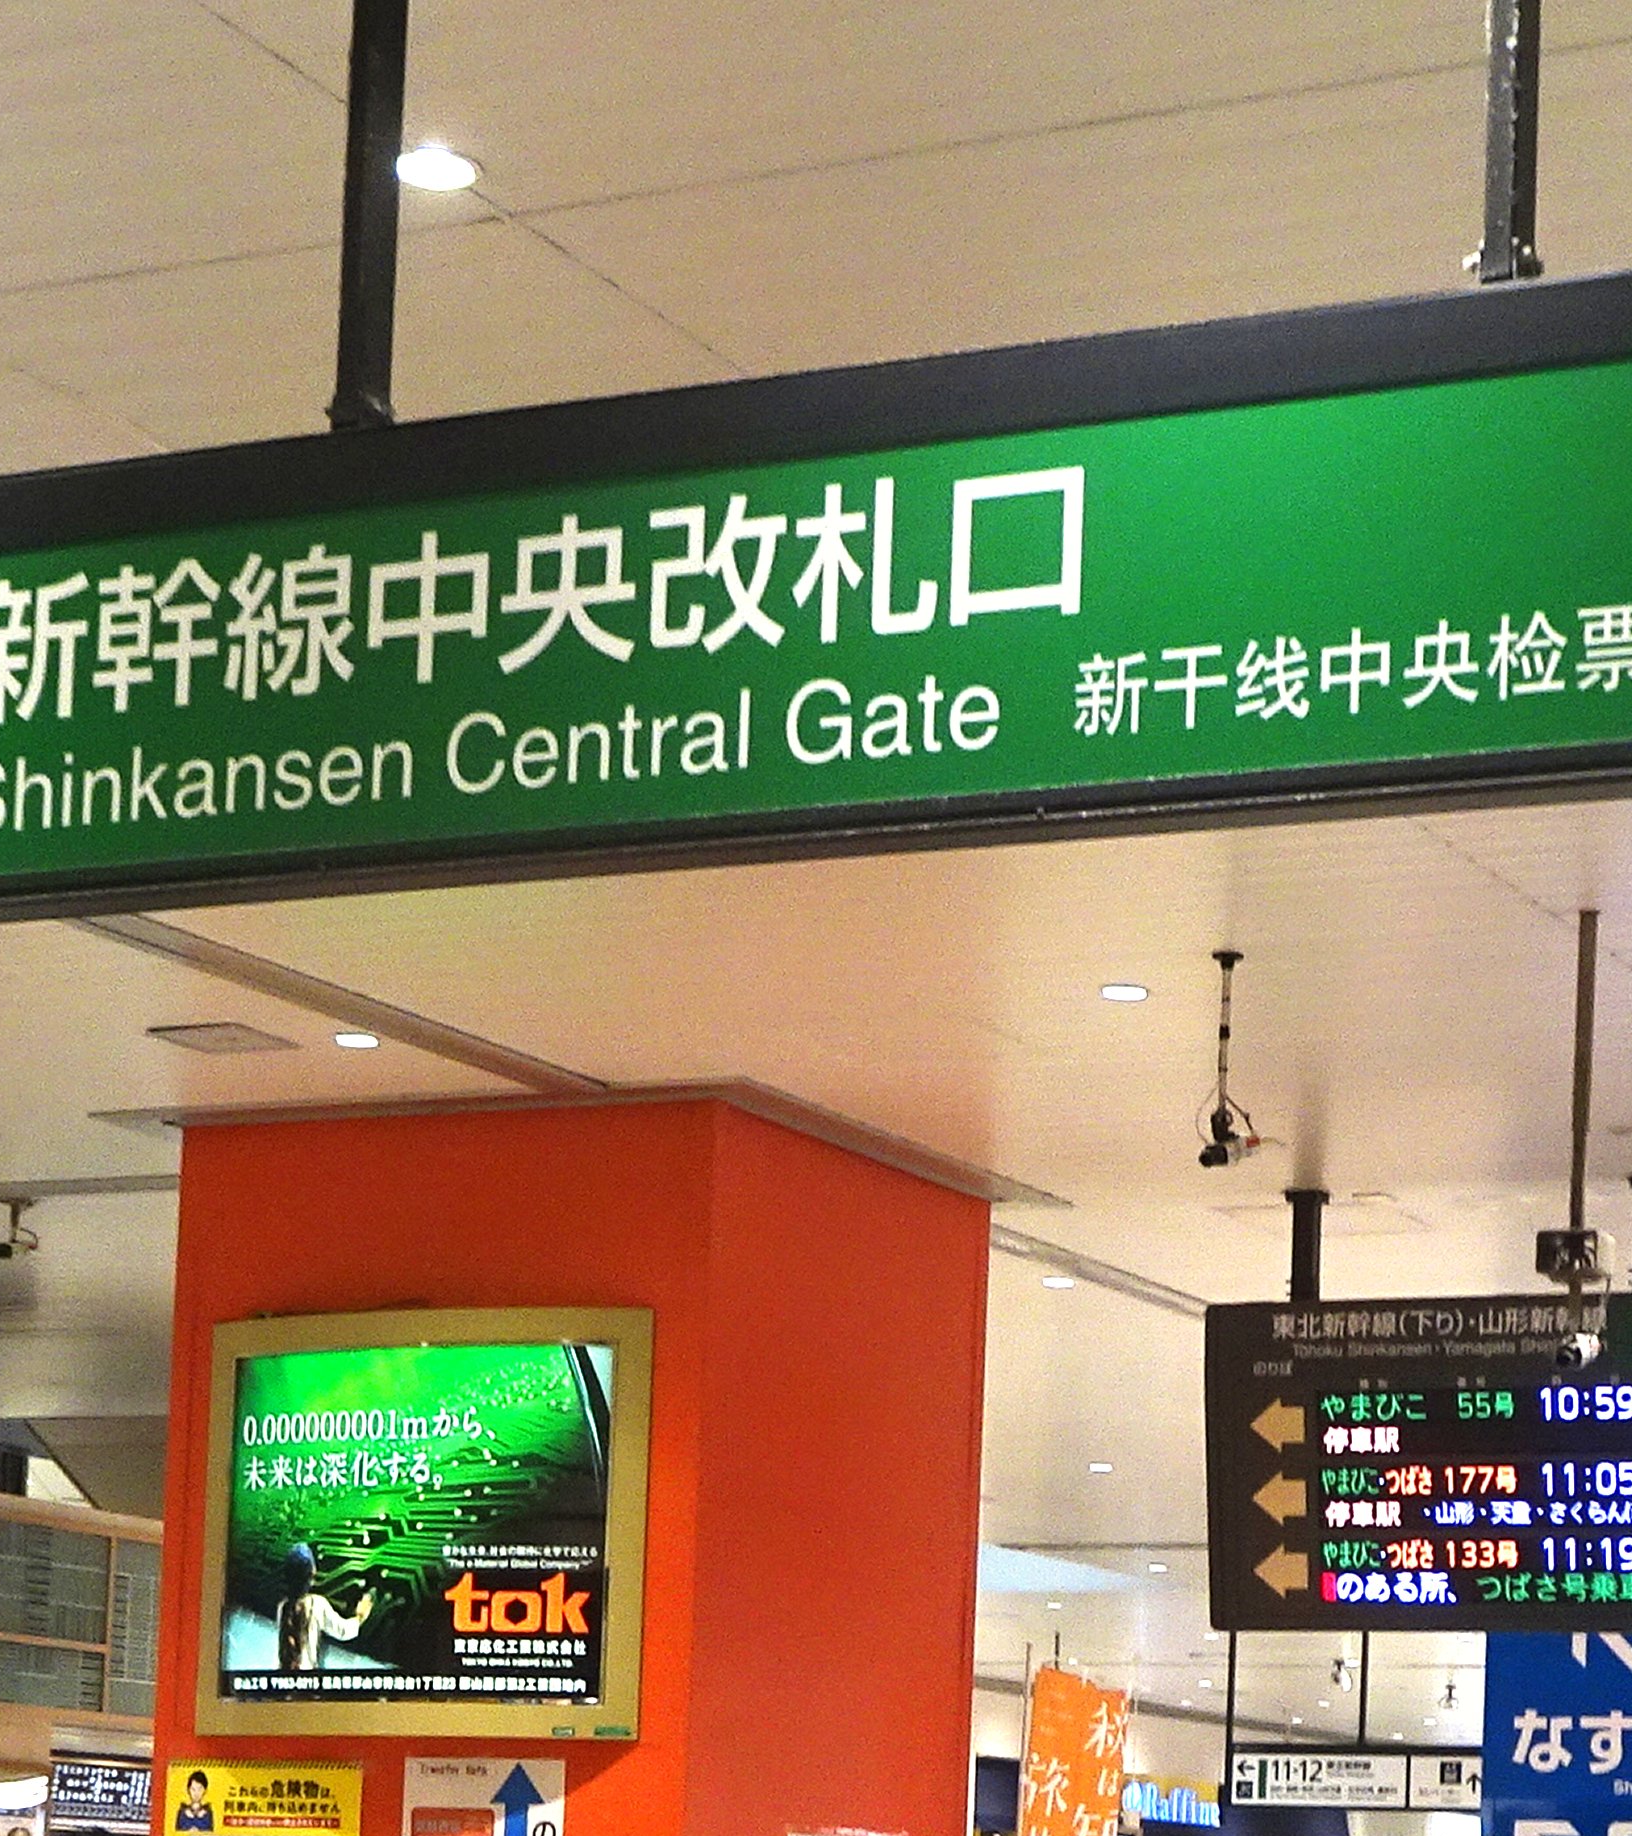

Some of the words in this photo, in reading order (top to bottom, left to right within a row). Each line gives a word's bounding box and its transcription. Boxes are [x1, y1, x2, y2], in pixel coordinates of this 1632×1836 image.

[446, 687, 752, 793] Central
[785, 675, 1001, 765] Gate
[1321, 1393, 1427, 1422] やまびこ
[1458, 1393, 1515, 1422] 55号
[1323, 1427, 1400, 1454] 停車駅
[244, 1450, 444, 1492] 未来は深化する。
[1444, 1465, 1518, 1496] 177号
[1325, 1500, 1401, 1527] 停車駅
[1446, 1539, 1519, 1569] 133号
[444, 1571, 591, 1634] tok
[1141, 1782, 1221, 1829] Raffine
